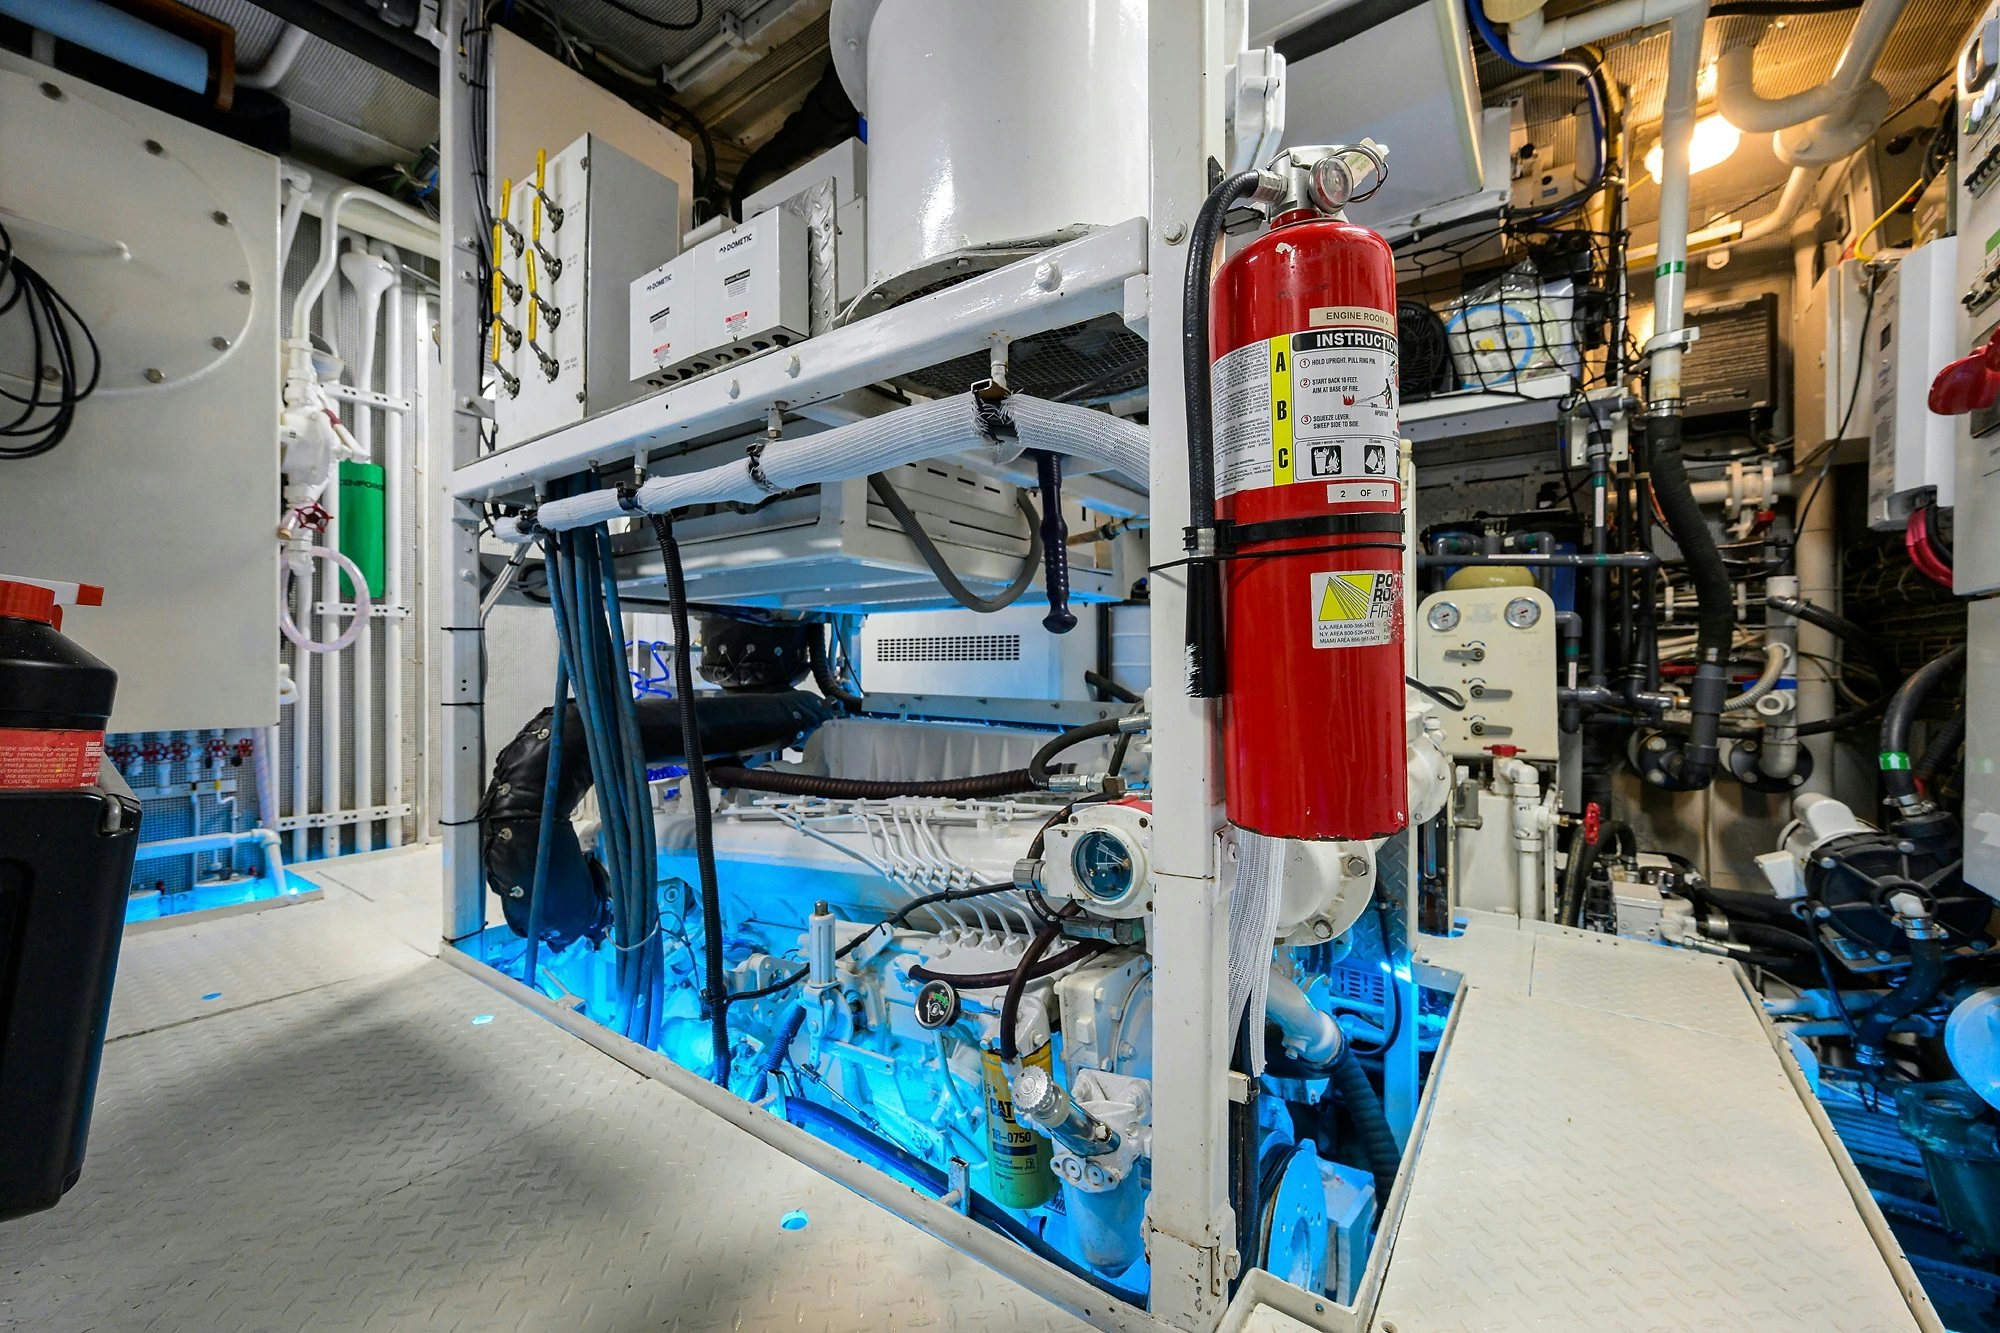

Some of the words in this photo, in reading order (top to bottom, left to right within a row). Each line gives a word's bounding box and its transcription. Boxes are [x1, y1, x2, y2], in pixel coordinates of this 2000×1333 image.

[726, 233, 752, 251] DOMETIC
[652, 274, 672, 290] DOMETIC
[1326, 312, 1362, 320] ENGINE
[1363, 312, 1385, 324] ROOM
[1276, 352, 1286, 373] A
[1277, 400, 1287, 421] B
[1313, 414, 1334, 422] SQUEEZE
[1278, 448, 1289, 468] C
[1340, 490, 1346, 498] 2
[1360, 489, 1372, 497] OF
[990, 1096, 1013, 1119] CAT
[992, 1128, 1032, 1143] 1R-0750
